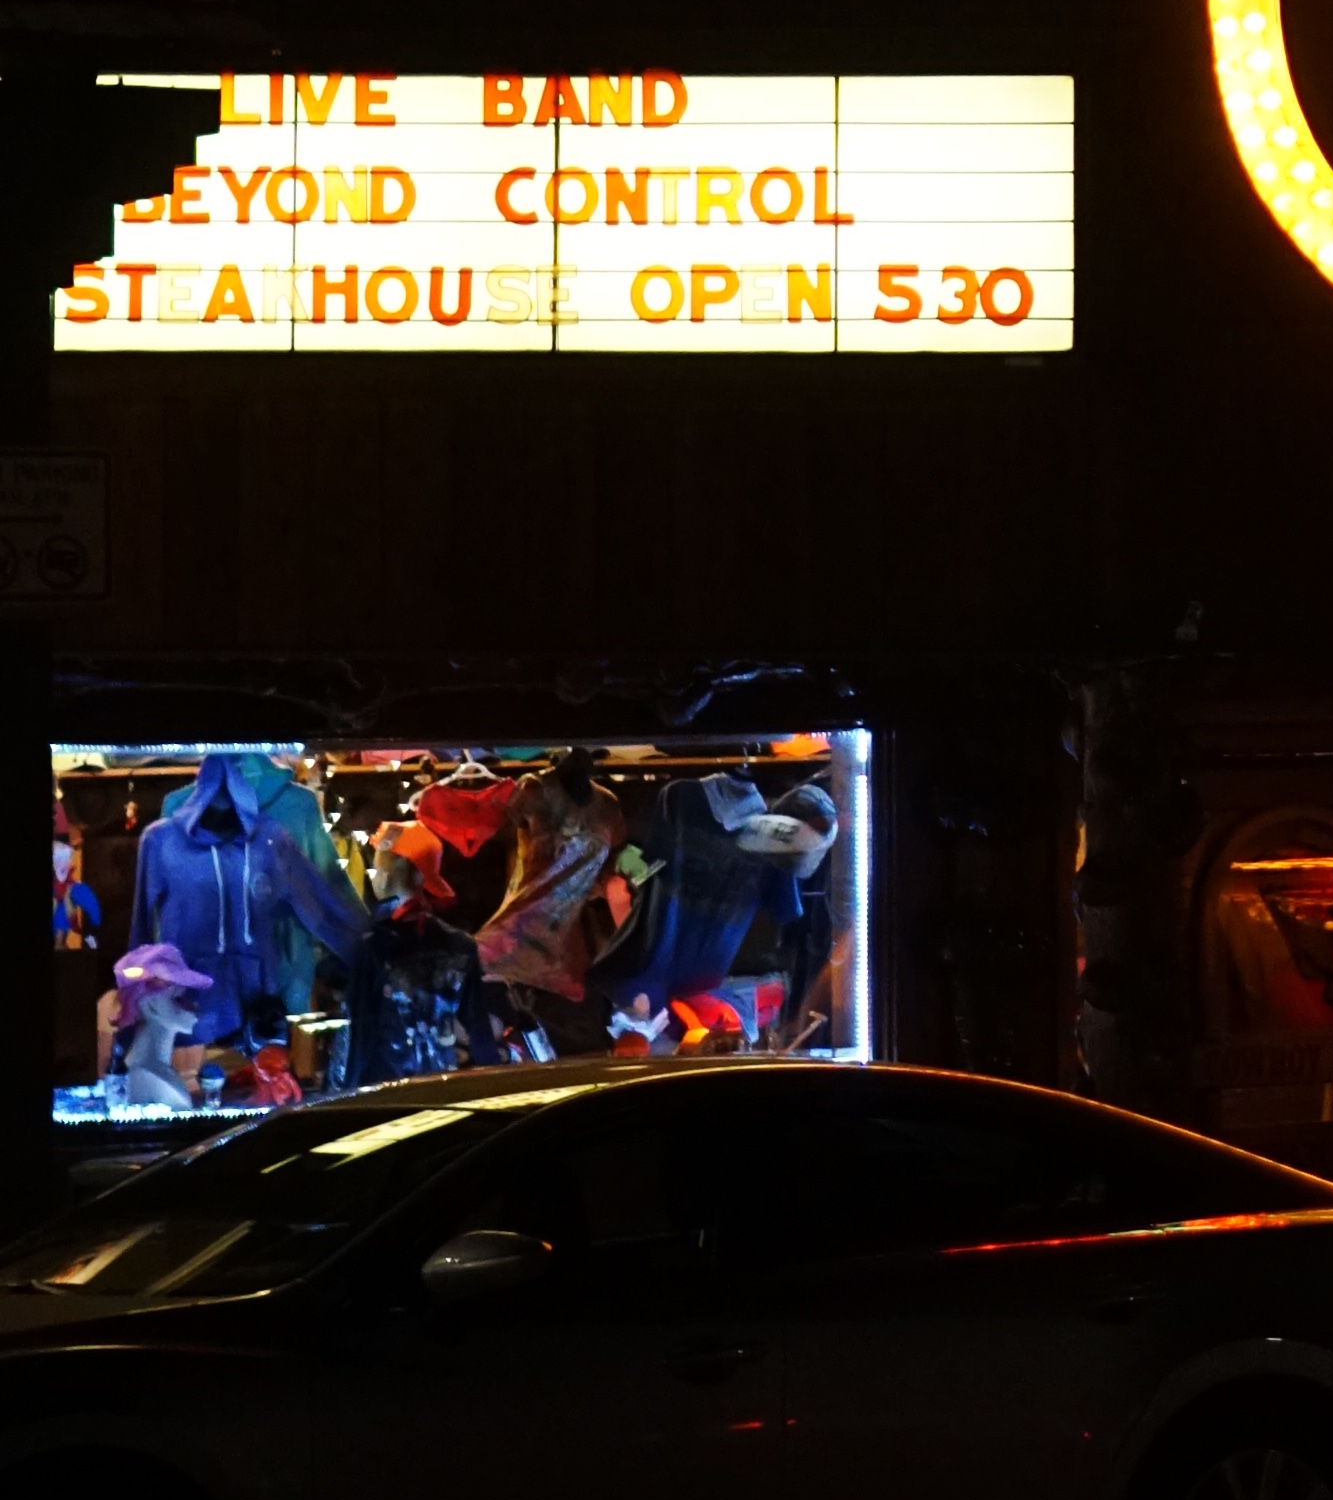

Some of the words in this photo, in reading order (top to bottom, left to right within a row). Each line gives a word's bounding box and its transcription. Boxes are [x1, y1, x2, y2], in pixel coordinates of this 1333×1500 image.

[219, 70, 398, 126] LIVE
[482, 68, 688, 128] BAND
[494, 166, 854, 225] CONTROL
[60, 262, 579, 326] STEAKHOUSE
[630, 263, 832, 324] OPEN
